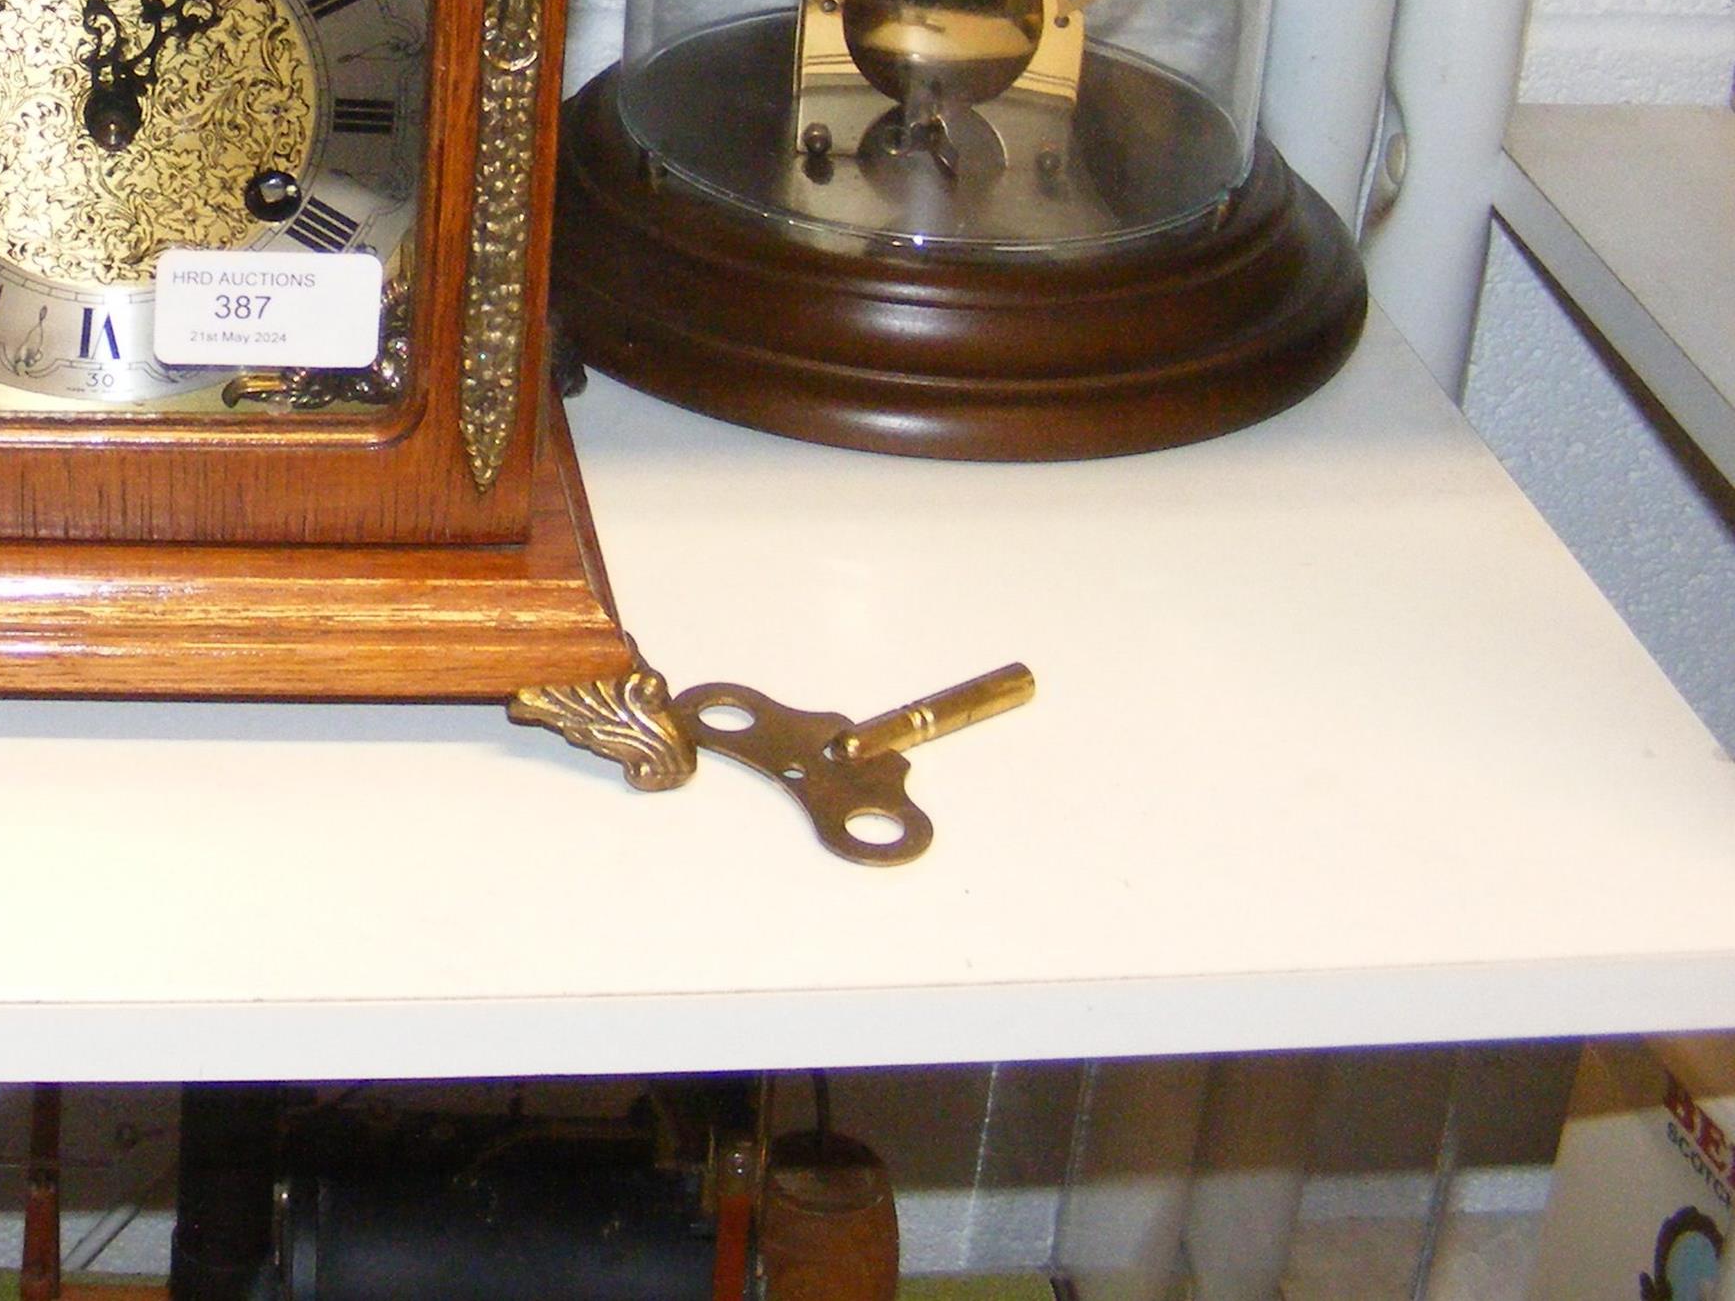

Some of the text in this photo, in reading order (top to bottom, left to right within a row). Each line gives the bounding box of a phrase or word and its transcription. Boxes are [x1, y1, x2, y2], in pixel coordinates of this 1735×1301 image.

[332, 98, 396, 134] III
[171, 270, 317, 288] HRD AUCTIONS
[213, 294, 272, 320] 387
[80, 307, 121, 359] VI
[190, 331, 288, 345] 21st May 2024
[86, 372, 115, 388] 30
